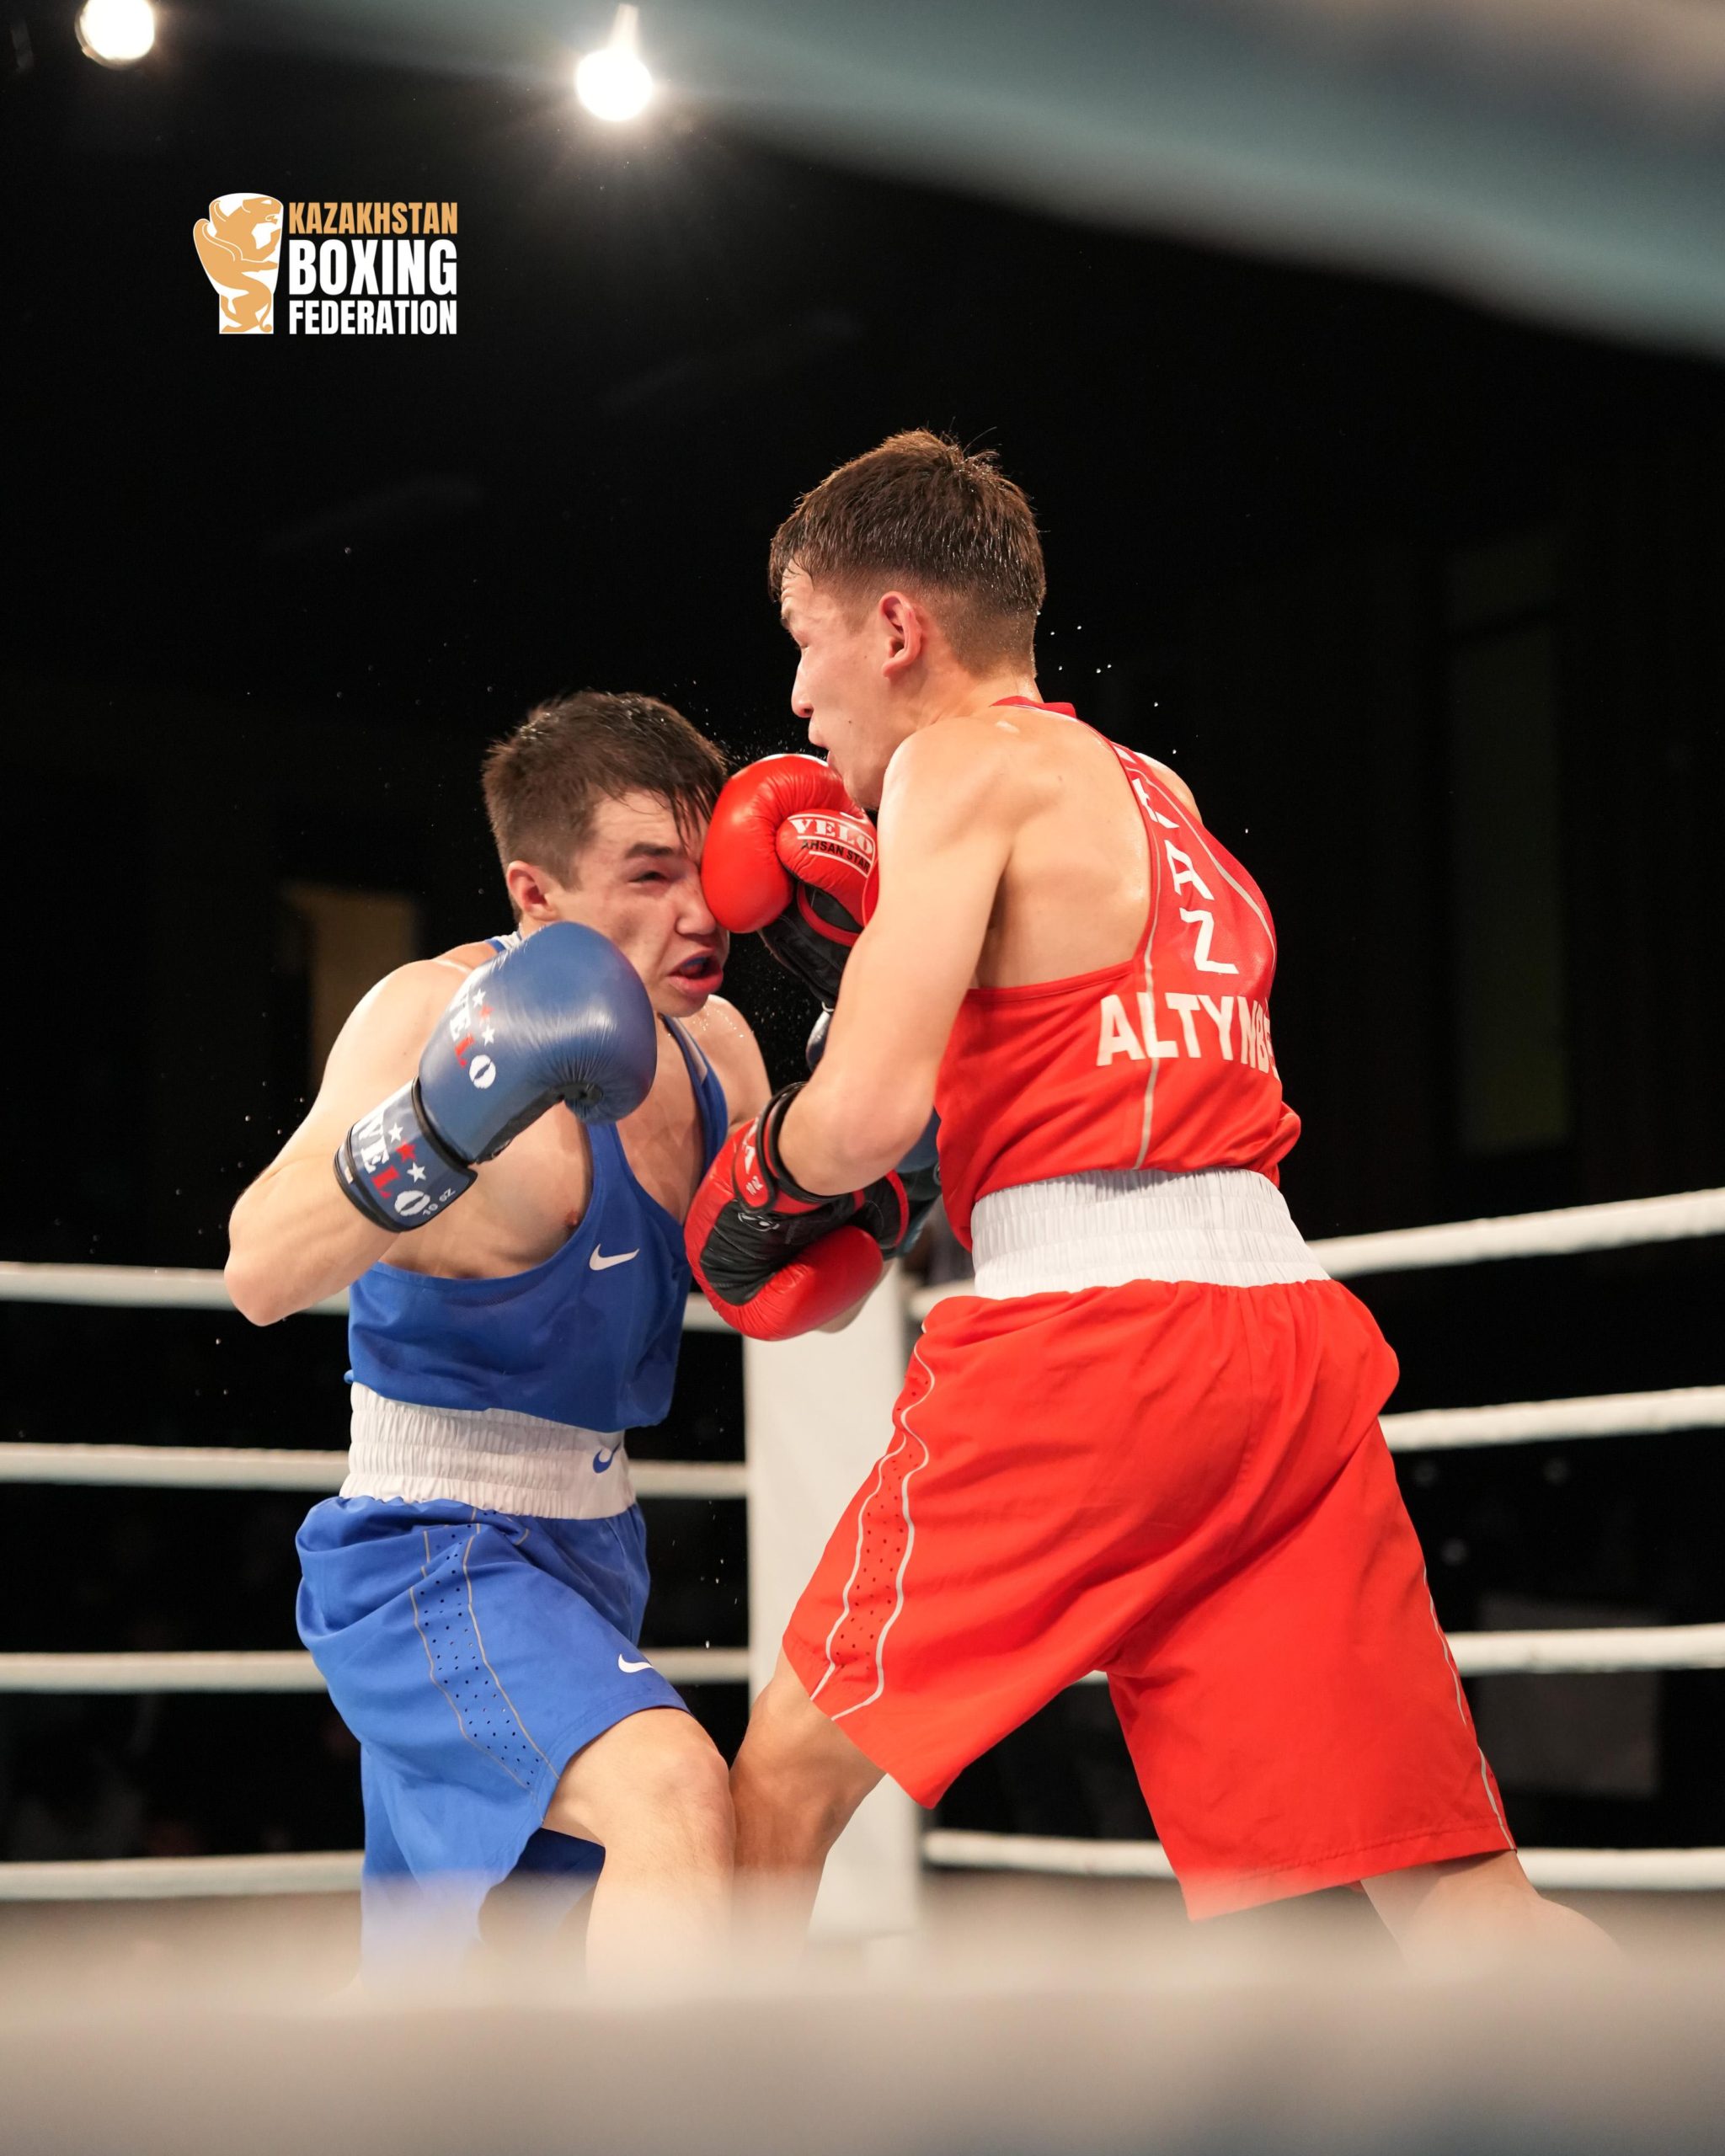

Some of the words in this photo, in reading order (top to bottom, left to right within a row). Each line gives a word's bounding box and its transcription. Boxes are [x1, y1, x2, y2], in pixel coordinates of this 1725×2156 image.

[790, 819, 873, 854] VELO
[801, 840, 844, 857] AHSAN
[846, 850, 871, 873] STAR
[358, 1112, 431, 1216] VELO
[423, 1203, 438, 1215] 10
